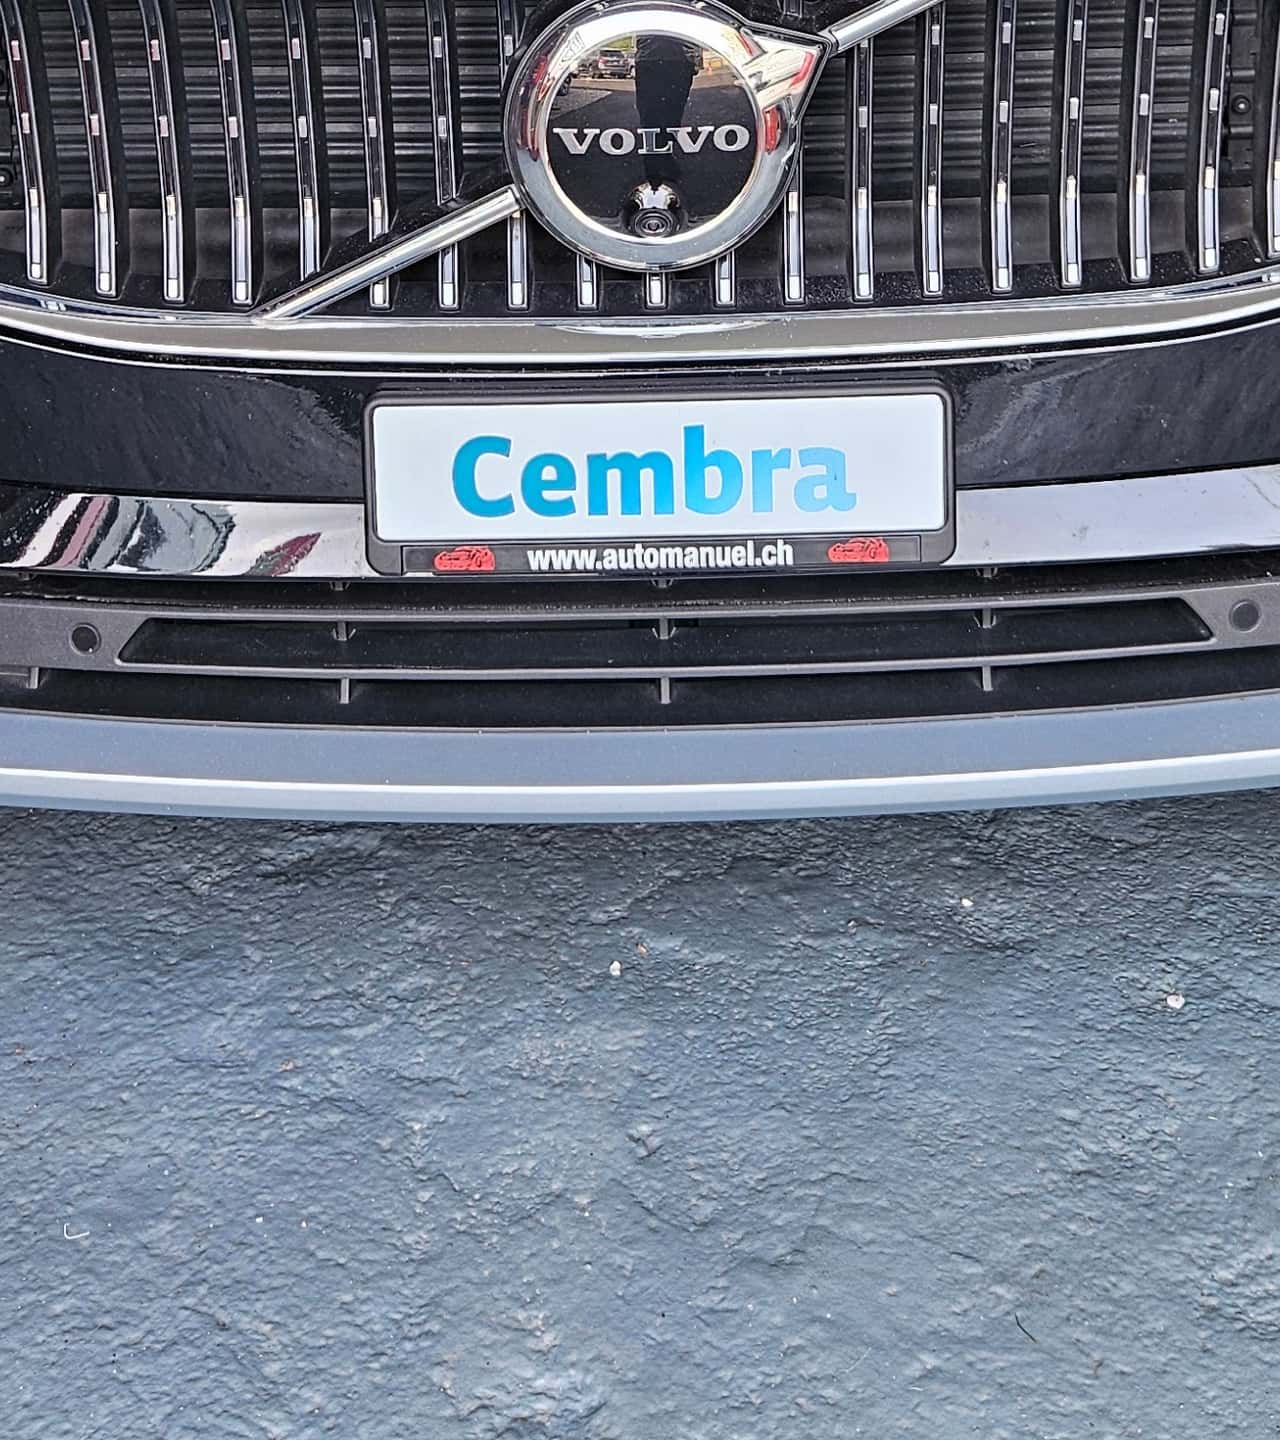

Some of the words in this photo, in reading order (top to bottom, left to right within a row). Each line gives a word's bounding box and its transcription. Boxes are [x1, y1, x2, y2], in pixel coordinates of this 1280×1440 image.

[553, 125, 750, 156] VOLVO
[452, 424, 857, 518] Cembra
[527, 538, 794, 571] www.automanuel.ch
